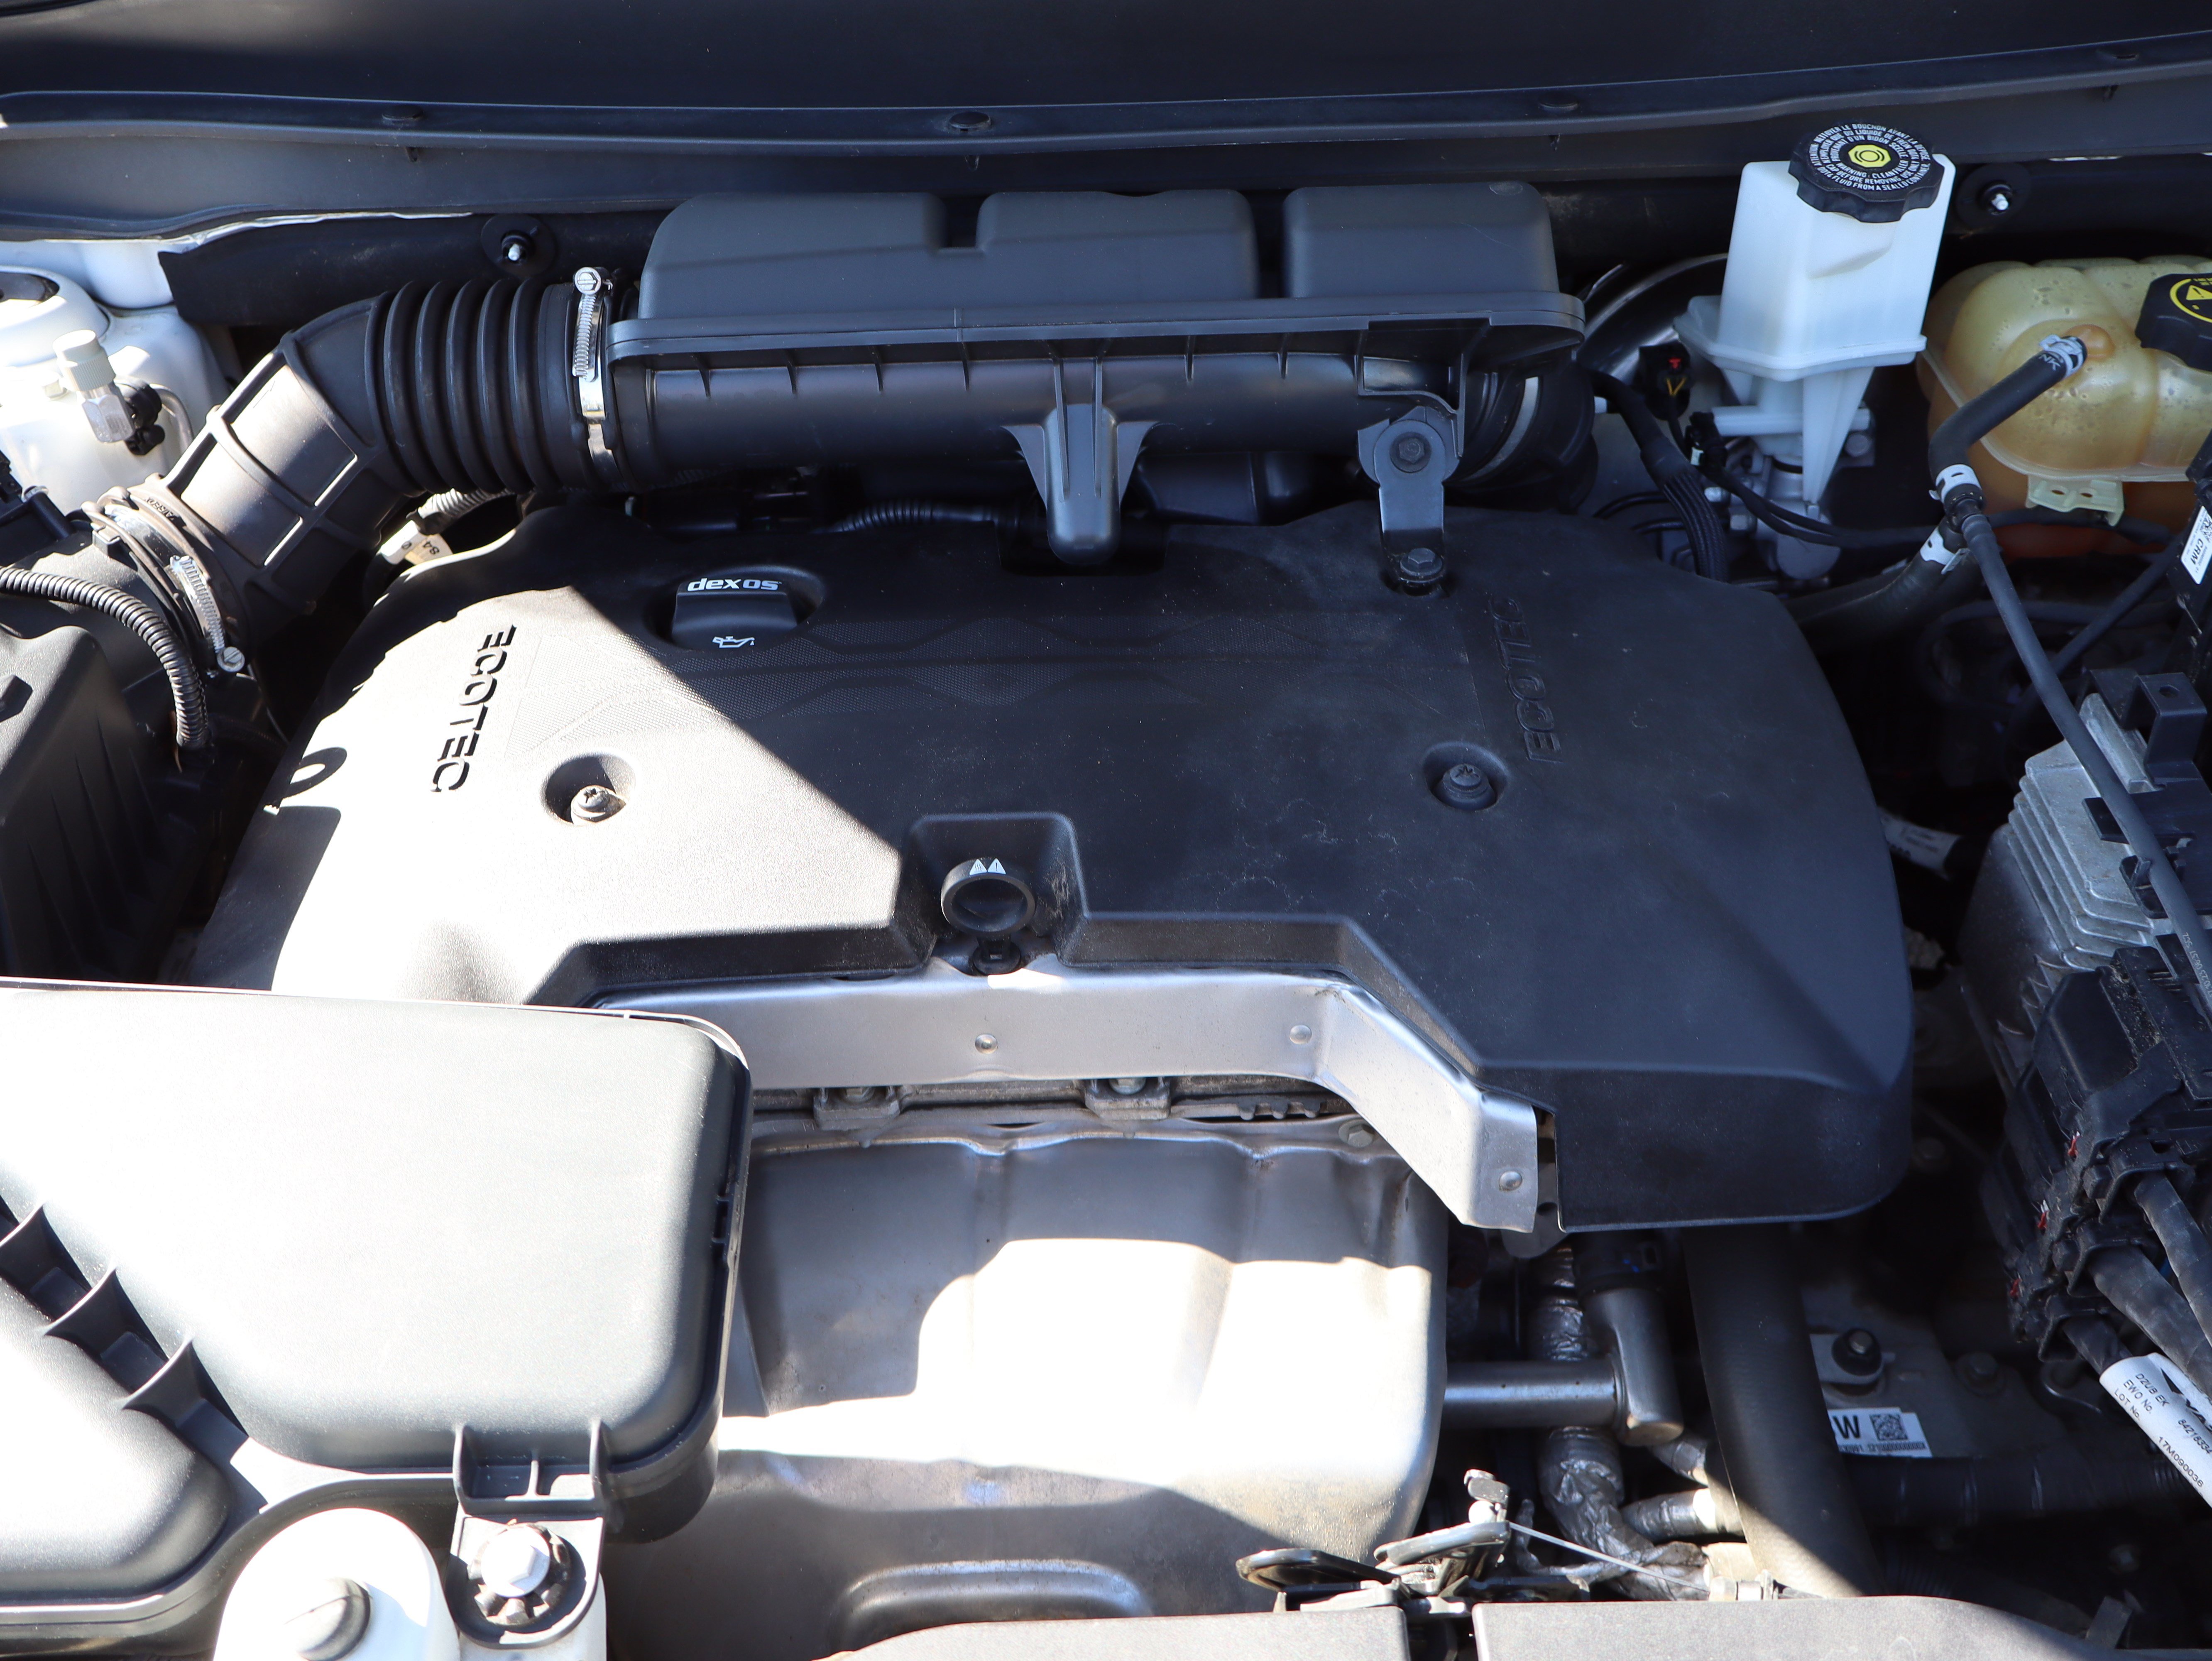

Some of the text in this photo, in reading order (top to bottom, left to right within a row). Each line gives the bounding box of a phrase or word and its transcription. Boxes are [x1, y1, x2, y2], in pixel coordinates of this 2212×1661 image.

[1867, 135, 1890, 144] BIDON
[1887, 128, 1910, 140] AVANT
[1893, 137, 1912, 149] FREIN
[1832, 175, 1852, 186] FLUID
[1882, 181, 1909, 191] SEALED
[1836, 171, 1864, 183] BEFORE
[1865, 176, 1901, 184] REMOVING
[1900, 170, 1914, 179] USE
[1872, 170, 1896, 179] CLEAN
[2190, 538, 2204, 565] CRM
[688, 578, 780, 592] dexos
[1488, 598, 1563, 763] ECOTEC
[430, 624, 516, 792] ECOTEC
[2123, 1379, 2153, 1414] EWO No.
[2135, 1373, 2158, 1394] D2UB
[2155, 1394, 2170, 1407] EK
[2178, 1418, 2212, 1454] 84218334
[1833, 1415, 1861, 1439] W
[2114, 1387, 2131, 1406] LOT
[2130, 1405, 2141, 1421] No.
[2158, 1436, 2204, 1487] 17M090036
